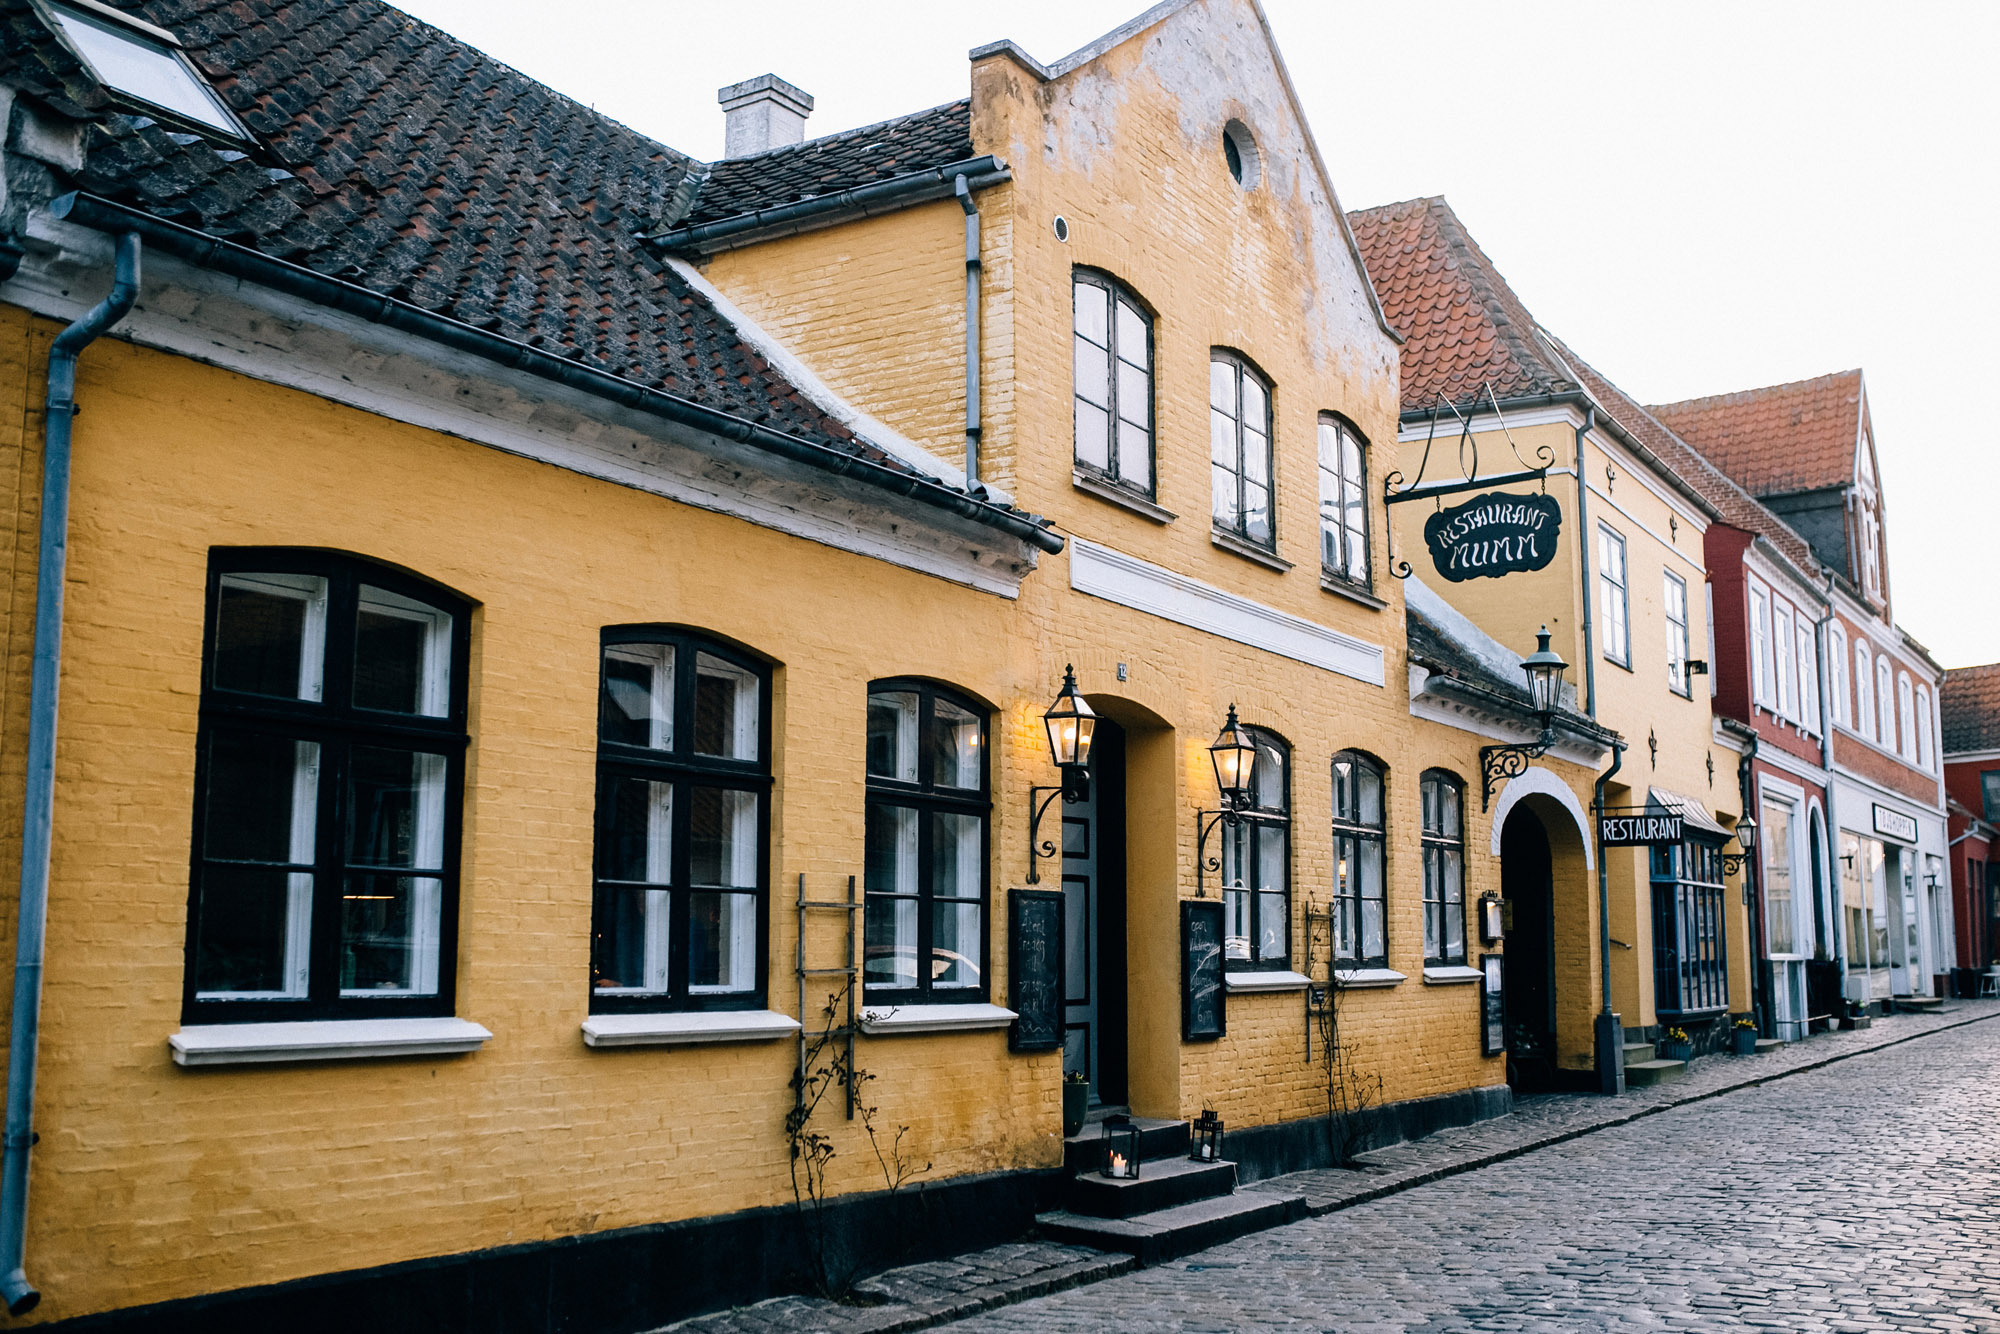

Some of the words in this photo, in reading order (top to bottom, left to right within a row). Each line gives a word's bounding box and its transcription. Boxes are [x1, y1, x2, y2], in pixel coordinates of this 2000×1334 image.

[1436, 503, 1550, 549] RESTAURANT
[1450, 533, 1539, 569] MUMM
[1602, 818, 1682, 841] RESTAURANT
